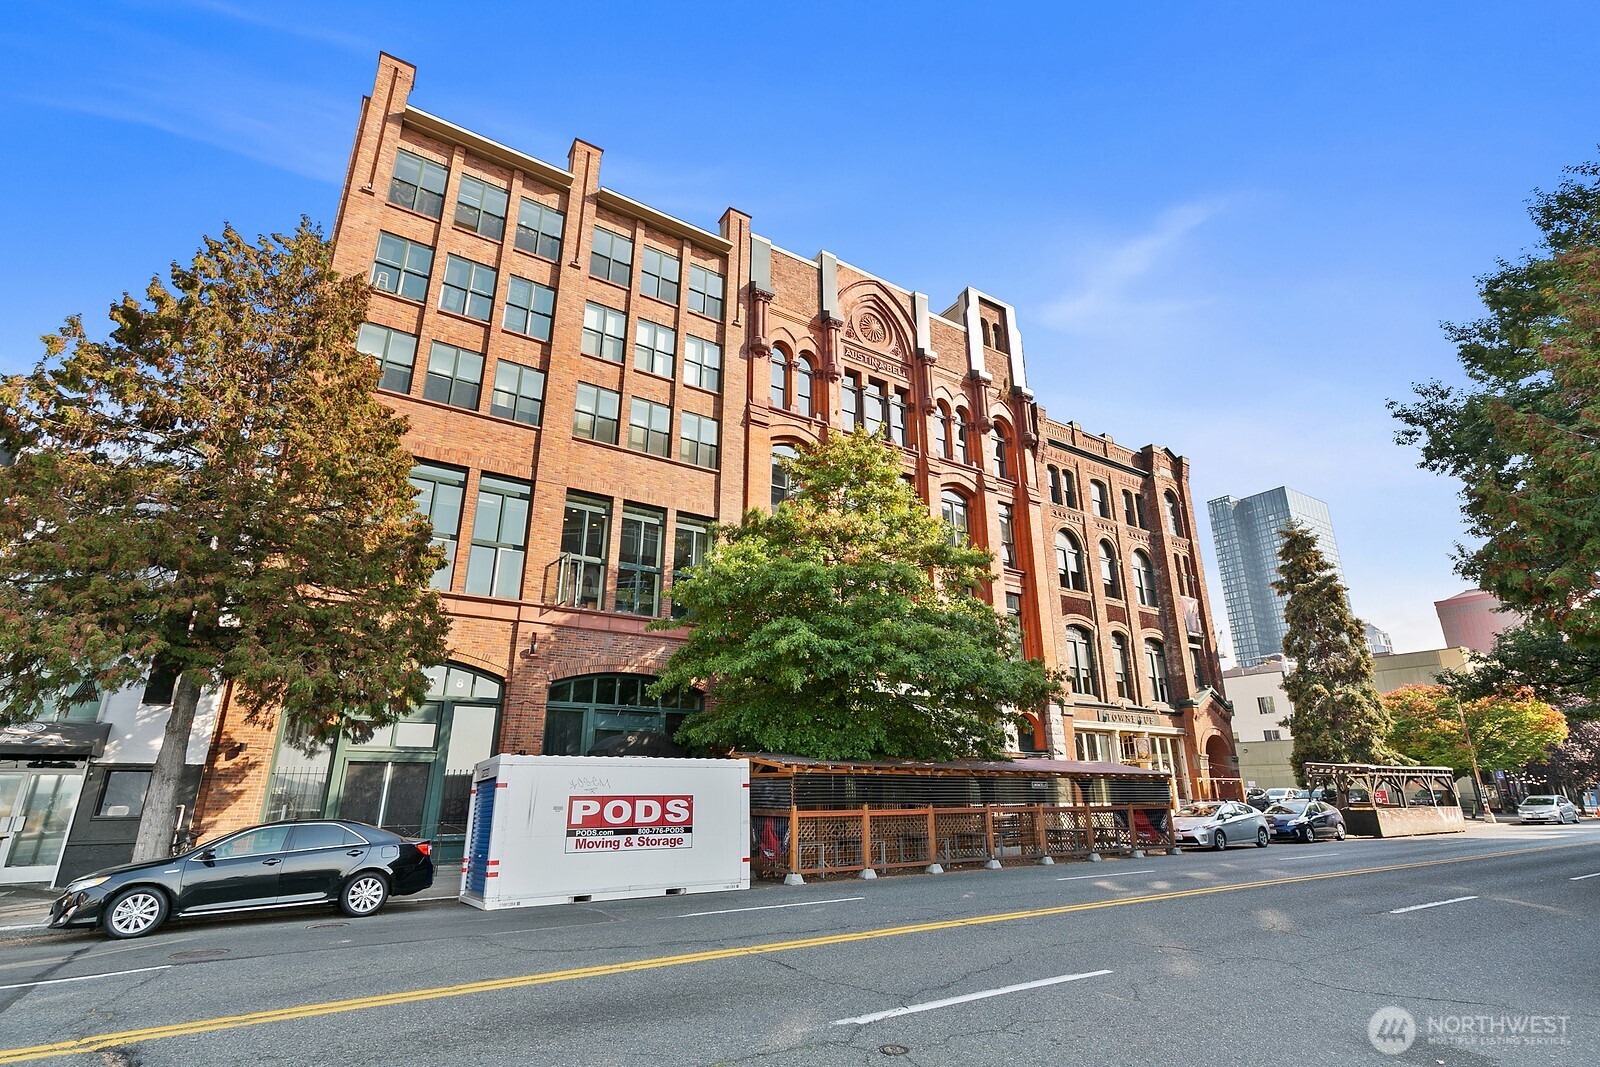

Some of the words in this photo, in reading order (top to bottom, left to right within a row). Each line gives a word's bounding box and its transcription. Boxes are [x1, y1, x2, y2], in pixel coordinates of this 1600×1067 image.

[887, 363, 906, 377] BELL
[571, 799, 690, 825] PODS
[575, 829, 615, 837] PODS.com
[637, 827, 685, 835] 800-776-PODS
[575, 837, 620, 850] Moving
[624, 836, 634, 848] &
[637, 835, 684, 848] Storage
